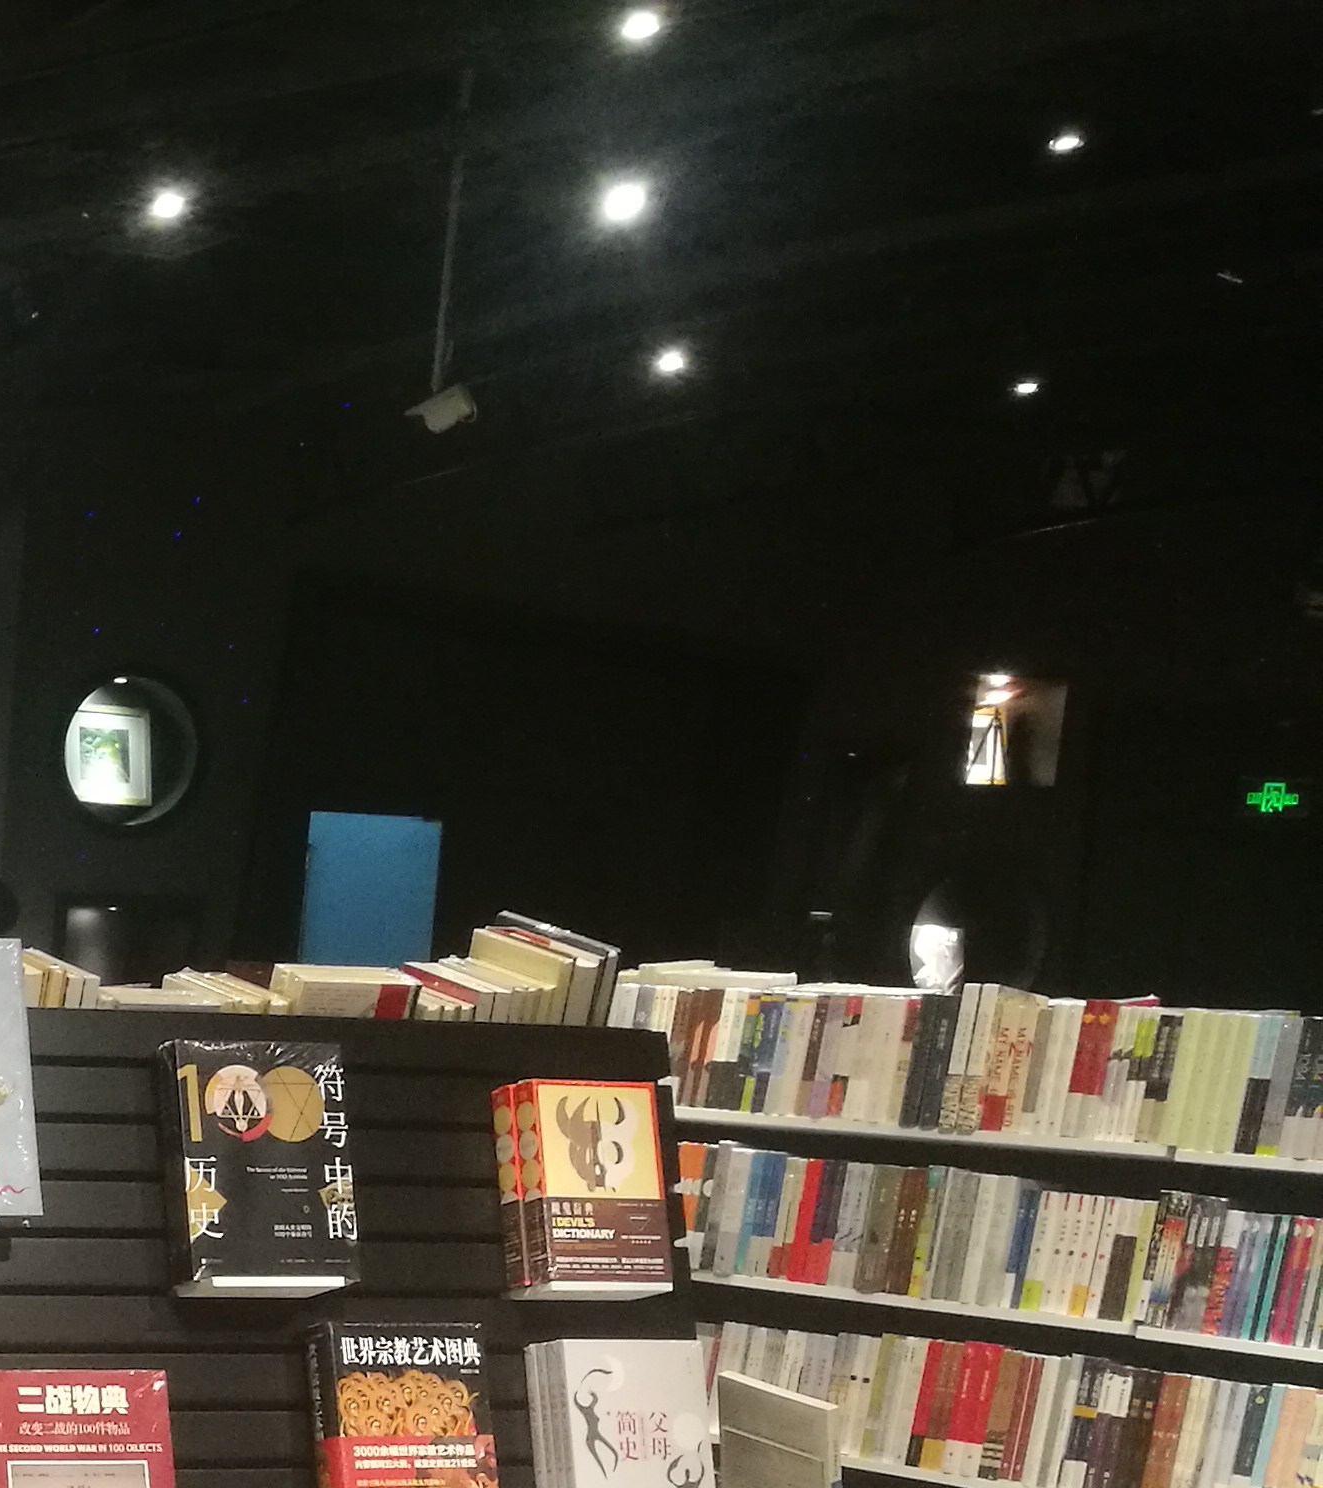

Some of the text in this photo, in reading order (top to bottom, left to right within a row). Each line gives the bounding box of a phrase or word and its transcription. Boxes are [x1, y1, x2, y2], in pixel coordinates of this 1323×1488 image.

[314, 1063, 358, 1241] 符号中的
[184, 1156, 225, 1245] 历史
[552, 1228, 615, 1240] DICTIONARY
[341, 1336, 482, 1366] 世界宗教艺术图典
[17, 1384, 130, 1415] 二战物典
[18, 1421, 131, 1436] 改变二战的100件物品
[615, 1409, 640, 1462] 简史
[649, 1411, 672, 1462] 父母
[8, 1443, 43, 1453] SECOND
[44, 1444, 77, 1453] WORLD
[108, 1443, 125, 1453] 100
